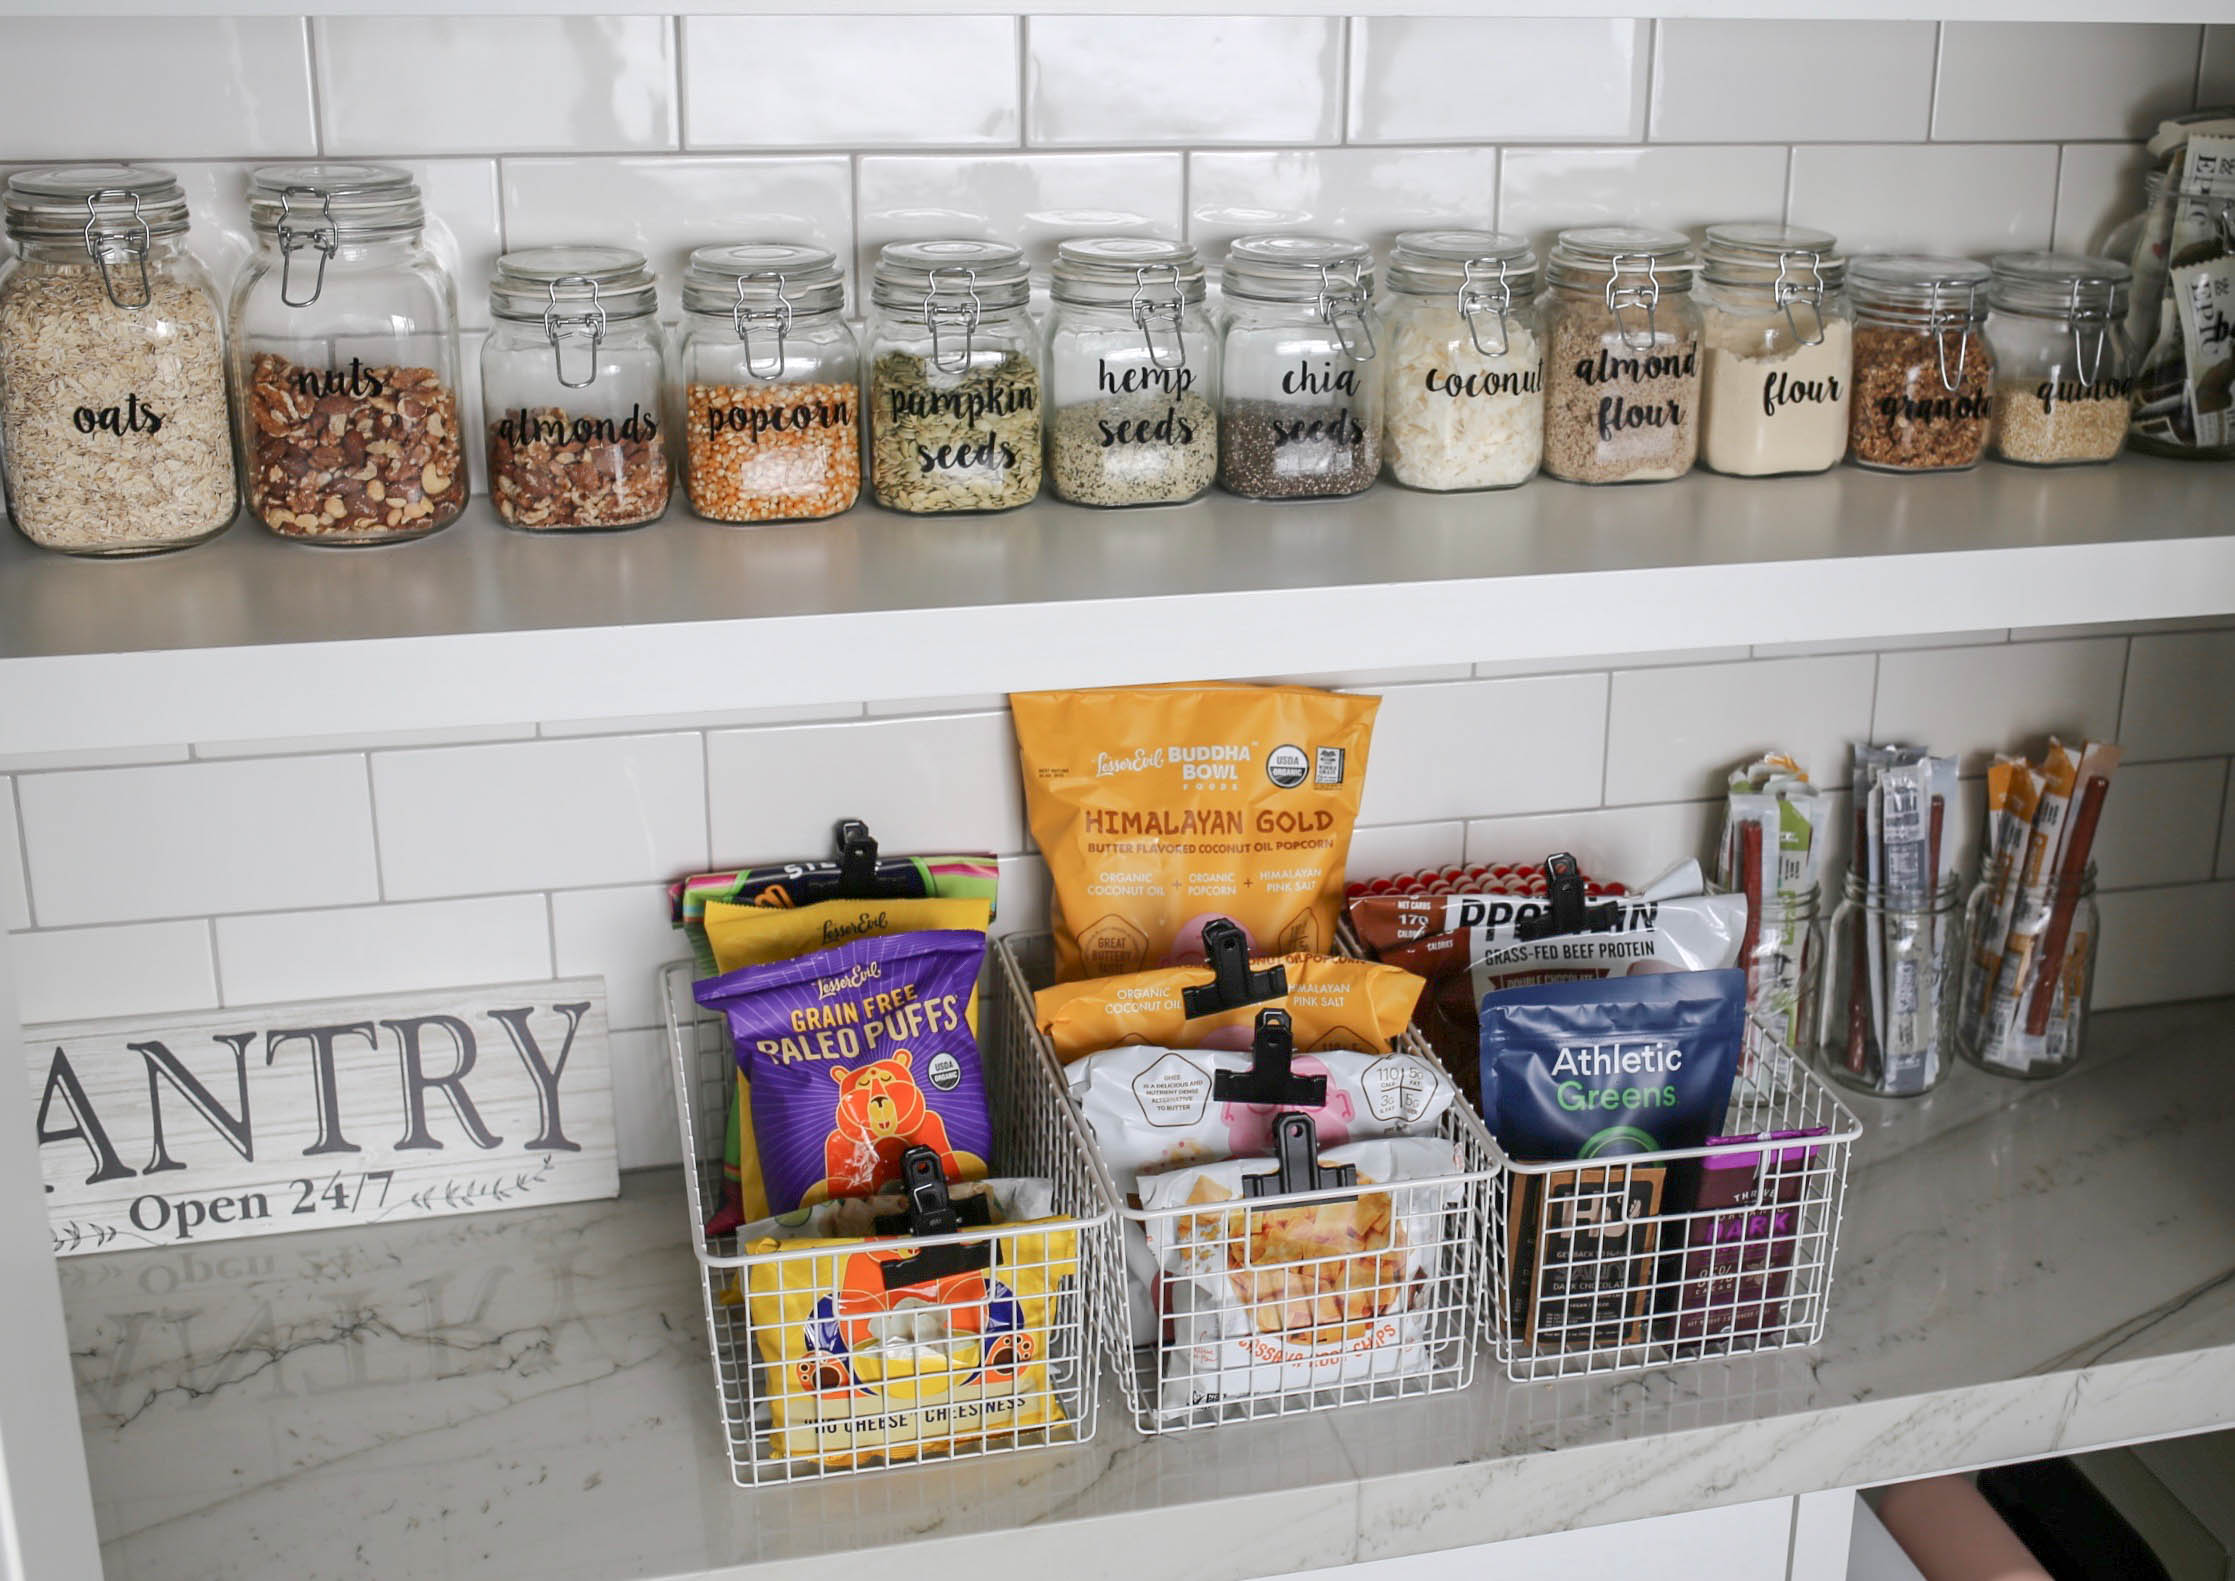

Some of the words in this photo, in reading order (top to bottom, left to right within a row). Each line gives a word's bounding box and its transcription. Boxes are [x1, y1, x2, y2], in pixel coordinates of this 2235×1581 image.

[299, 357, 384, 397] nuts
[1425, 357, 1544, 398] coconut
[1575, 340, 1699, 386] almond
[1098, 359, 1197, 399] hemp
[1281, 361, 1361, 399] chia
[890, 377, 1037, 428] pumpkin
[1763, 371, 1844, 420] flour
[73, 393, 164, 438] oats
[499, 403, 660, 448] almonds
[707, 400, 853, 446] popcorn
[1098, 408, 1199, 448] seeds
[1272, 408, 1365, 448] seeds
[1599, 396, 1686, 442] flour
[917, 431, 1022, 473] seeds
[1095, 748, 1165, 778] LesserEvil
[1168, 745, 1251, 763] BUDDHA
[1276, 755, 1299, 766] USDA
[1182, 763, 1239, 781] BOWL
[1272, 768, 1303, 777] ORGANIC
[1085, 809, 1243, 836] HIMALAYAN
[1256, 809, 1334, 833] GOLD
[1088, 842, 1134, 854] BUTTER
[1136, 842, 1196, 855] FLAVORED
[1199, 842, 1250, 855] COCONUT
[1254, 841, 1273, 853] OIL
[1276, 838, 1334, 852] POPCORN
[1099, 872, 1153, 884] ORGANIC
[1188, 872, 1236, 884] ORGANIC
[1259, 867, 1322, 881] HIMALAYAN
[1266, 882, 1292, 893] PINK
[1294, 880, 1317, 892] SALT
[1087, 885, 1144, 897] COCONUT
[1149, 885, 1166, 897] OIL
[1187, 884, 1237, 897] POPCORN
[1097, 937, 1126, 950] GREAT
[1485, 945, 1559, 966] GRASS-FED
[1563, 942, 1595, 960] BEEF
[1599, 940, 1655, 958] PROTEIN
[817, 960, 882, 1001] LesserEvil
[1116, 986, 1170, 1000] ORGANIC
[791, 1001, 859, 1033] GRAIN
[863, 984, 918, 1019] FREE
[1104, 1000, 1160, 1015] COCONUT
[1163, 998, 1182, 1012] OIL
[1293, 996, 1318, 1007] PINK
[1321, 996, 1345, 1008] SALT
[756, 1027, 860, 1066] PALEO
[863, 994, 959, 1050] PUFFS
[934, 1060, 954, 1072] USDA
[1376, 1067, 1399, 1081] 110
[1552, 1042, 1683, 1077] Athletic
[1556, 1079, 1677, 1113] Greens
[129, 1187, 272, 1240] Open
[289, 1169, 395, 1215] 24/7
[1703, 1213, 1792, 1243] DARK
[1553, 1283, 1577, 1291] DAK
